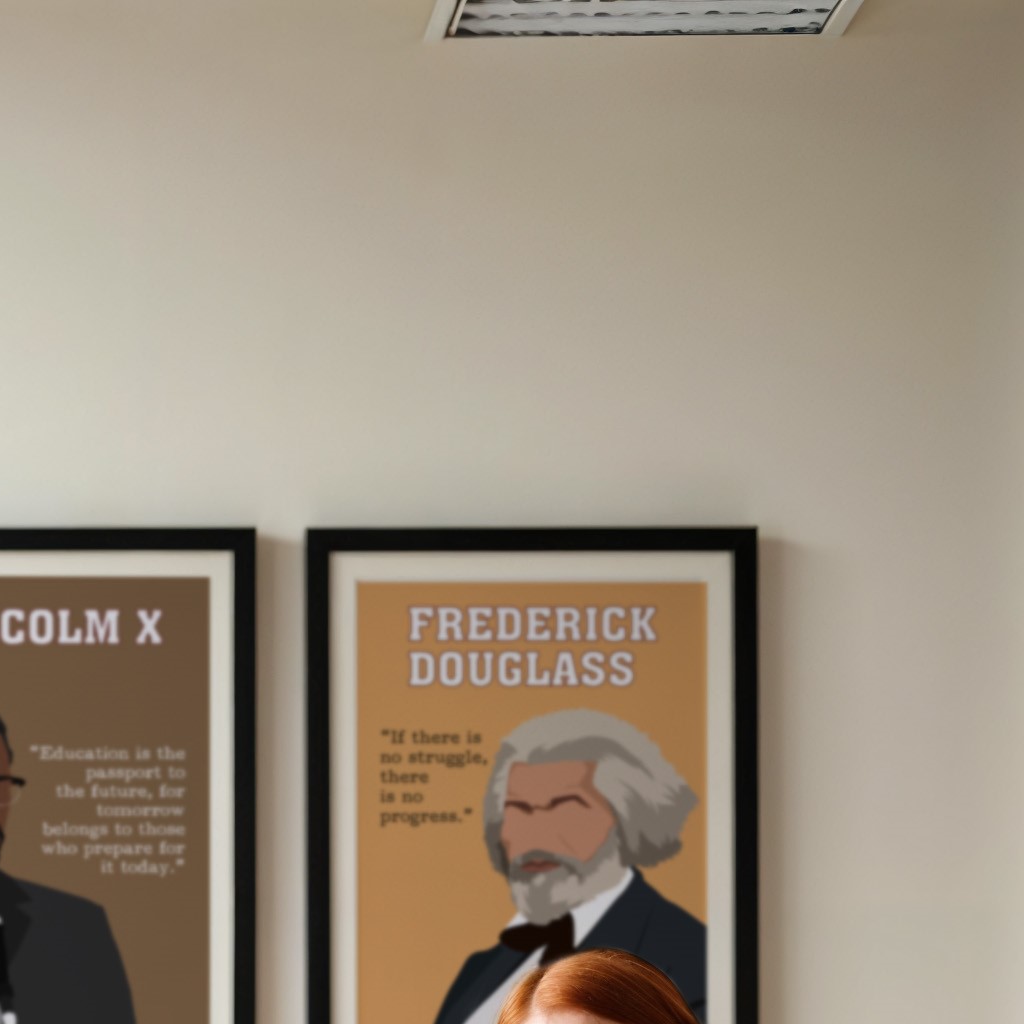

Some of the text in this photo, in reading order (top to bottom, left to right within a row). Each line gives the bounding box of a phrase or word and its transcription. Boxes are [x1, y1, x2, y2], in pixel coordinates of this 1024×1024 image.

[135, 609, 163, 645] X
[408, 605, 657, 642] FREDERICK
[408, 650, 635, 687] DOUGLASS
[380, 729, 482, 745] "If there is
[29, 745, 186, 761] "Education is the
[380, 749, 488, 768] no struggle,
[85, 765, 186, 781] passport to
[380, 769, 429, 784] there
[56, 784, 186, 801] the future, for
[380, 790, 424, 804] is no
[96, 804, 184, 817] tomorrow
[380, 808, 473, 827] progress."
[42, 822, 186, 840] belongs to those
[41, 841, 186, 859] who prepare for
[100, 859, 185, 878] it today."
